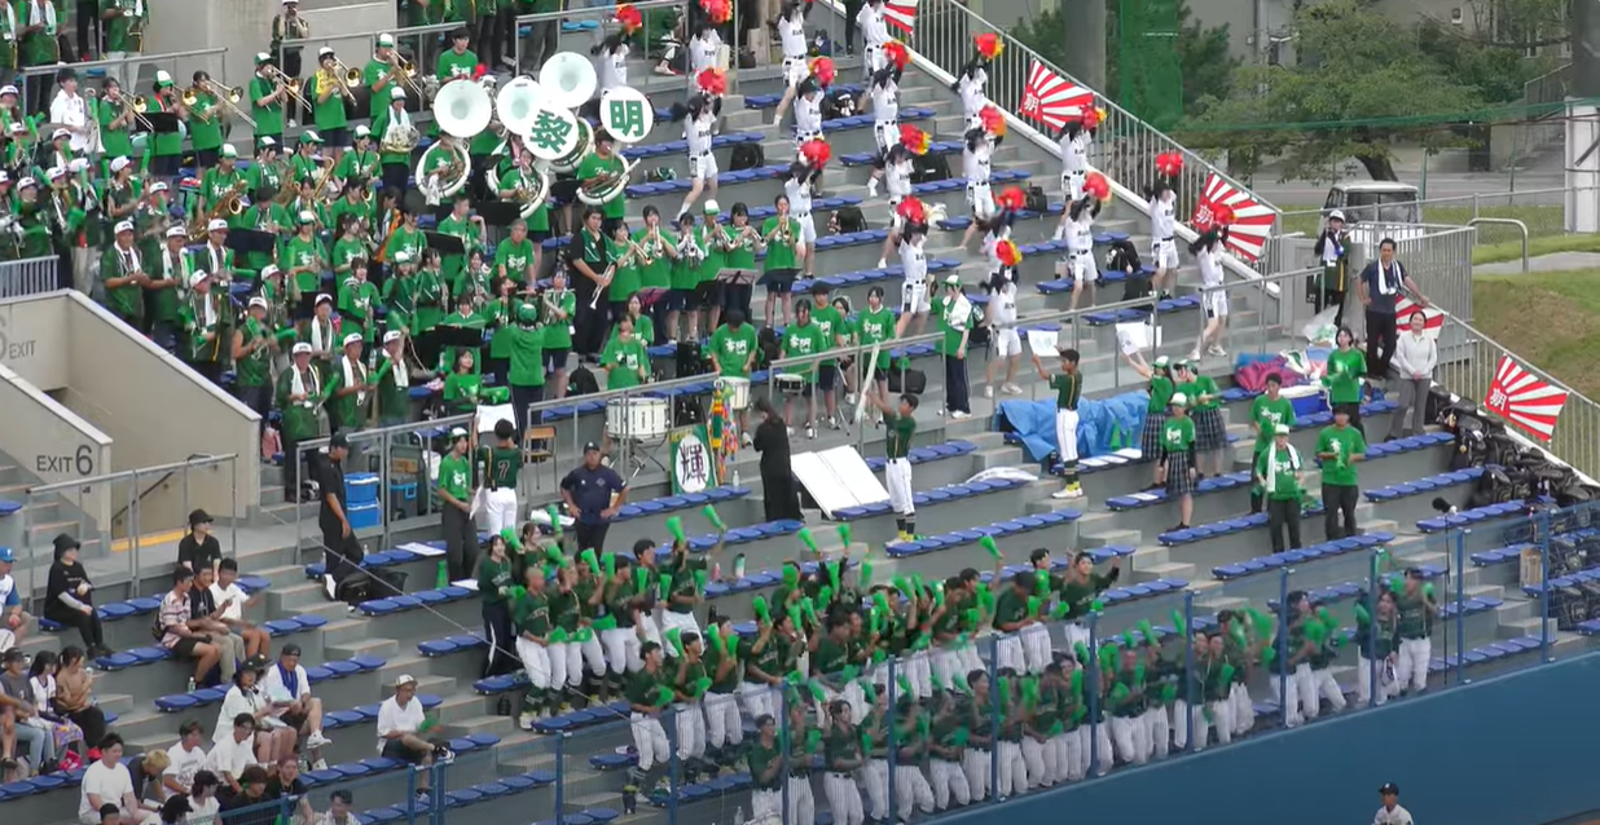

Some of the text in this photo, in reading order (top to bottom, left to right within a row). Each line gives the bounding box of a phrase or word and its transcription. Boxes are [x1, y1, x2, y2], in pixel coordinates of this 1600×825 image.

[529, 109, 573, 154] 黎
[609, 99, 644, 137] 明
[9, 339, 36, 359] EXIT
[36, 444, 93, 476] EXIT 6
[498, 460, 510, 479] 7
